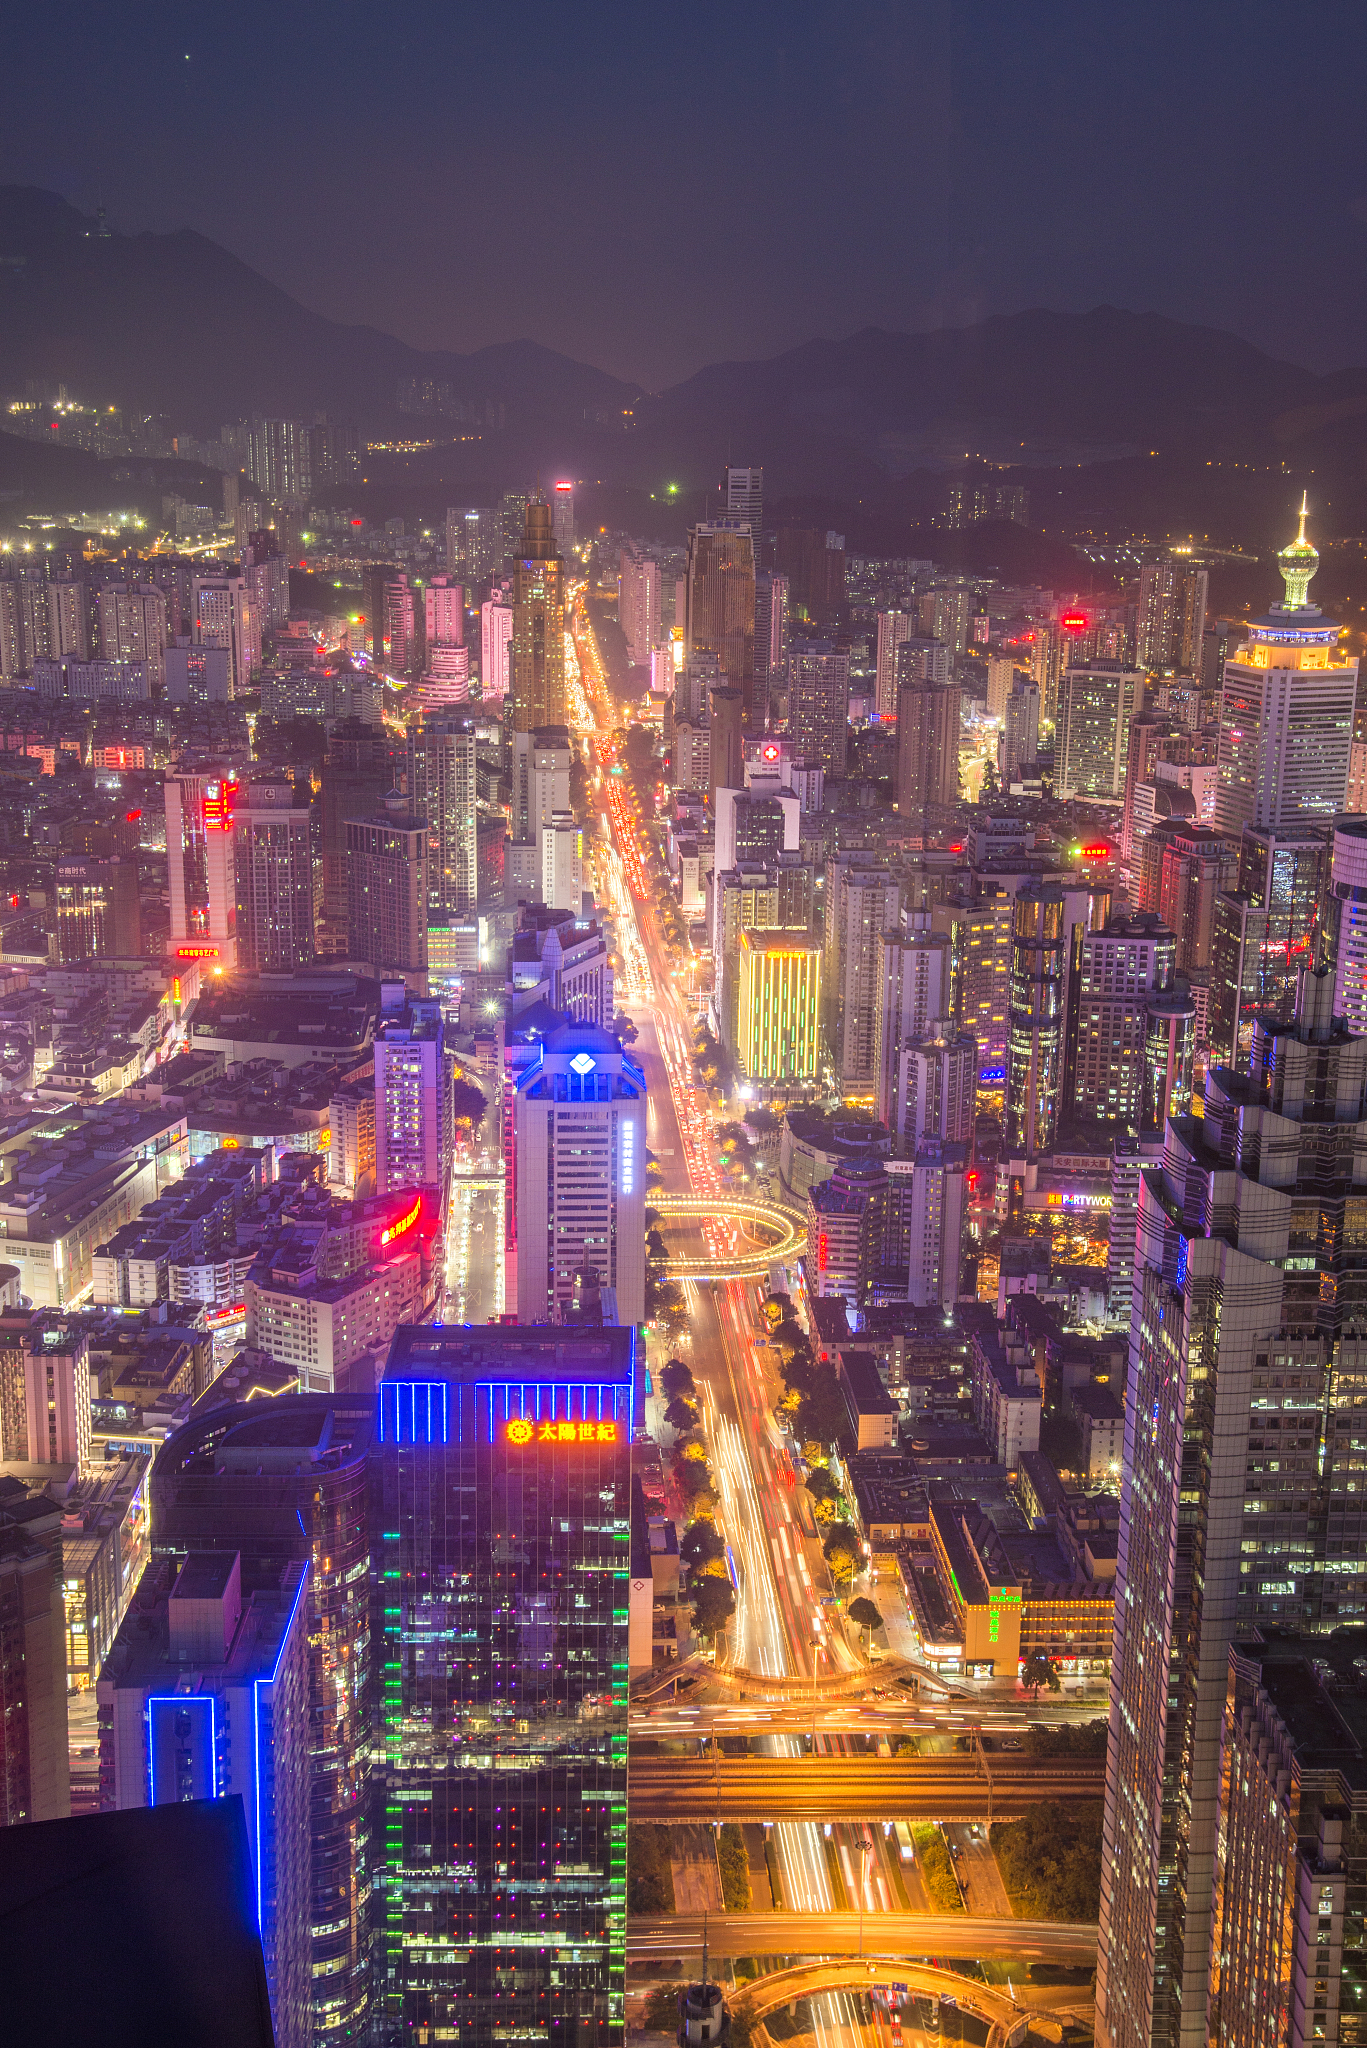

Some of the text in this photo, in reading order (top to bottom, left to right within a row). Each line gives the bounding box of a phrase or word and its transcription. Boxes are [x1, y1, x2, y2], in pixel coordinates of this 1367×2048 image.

[1054, 1157, 1107, 1168] 天安国际大厦
[538, 1422, 616, 1441] 太陽世紀
